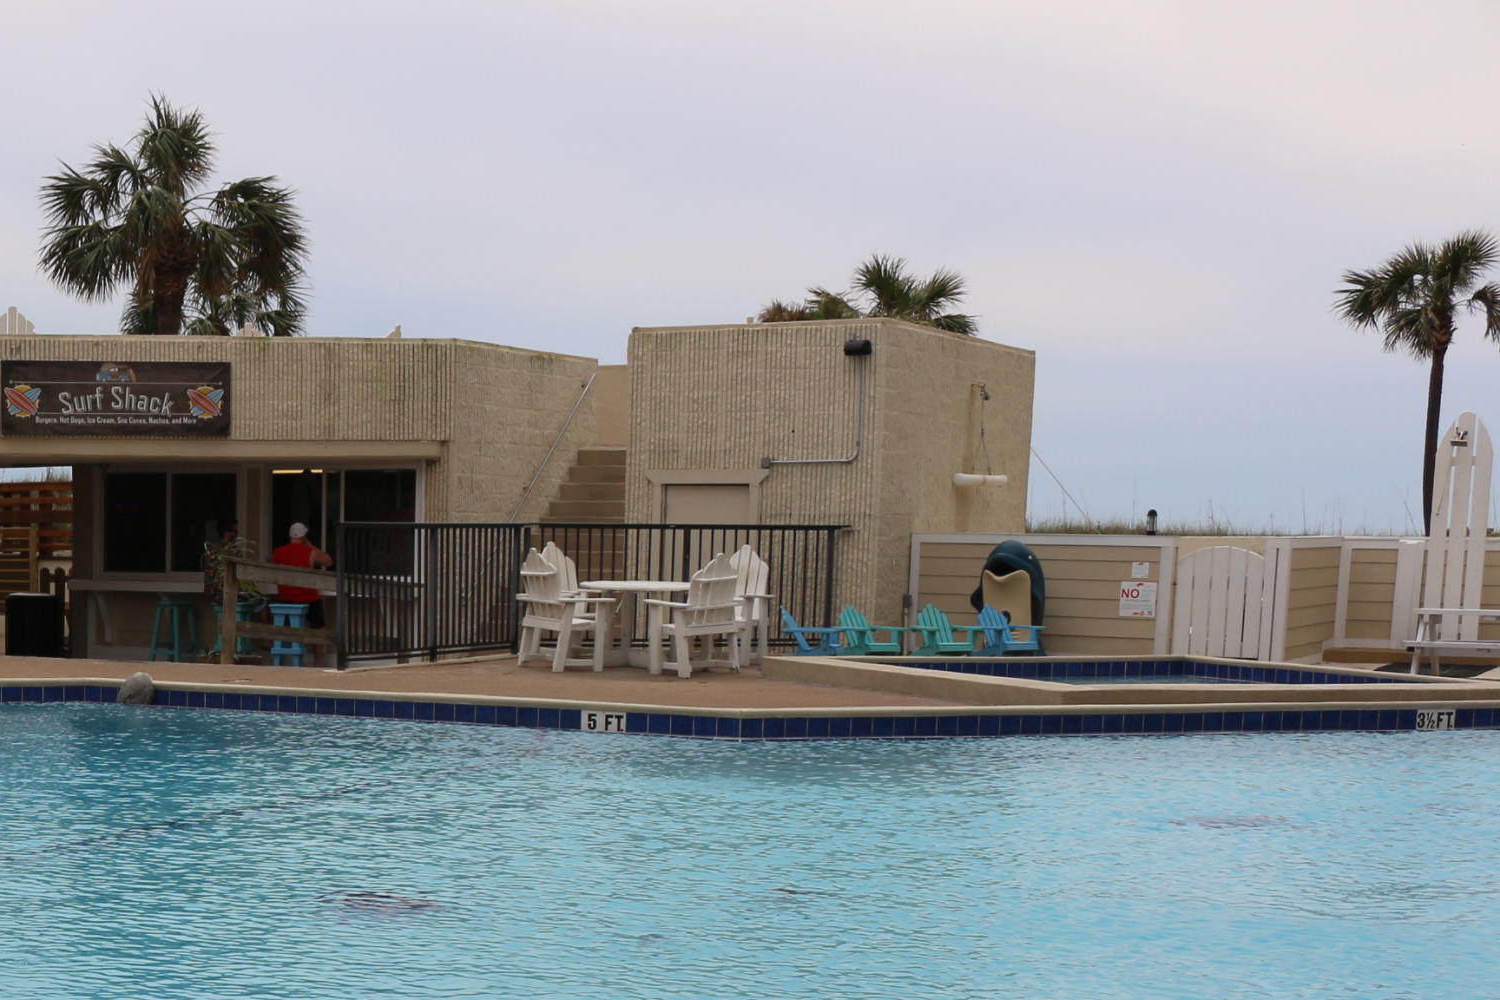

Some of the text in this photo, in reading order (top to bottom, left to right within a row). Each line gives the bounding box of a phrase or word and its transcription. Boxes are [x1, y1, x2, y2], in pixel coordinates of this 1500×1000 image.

[58, 386, 174, 417] Surf Shack
[1121, 588, 1140, 599] NO
[587, 713, 597, 730] 5
